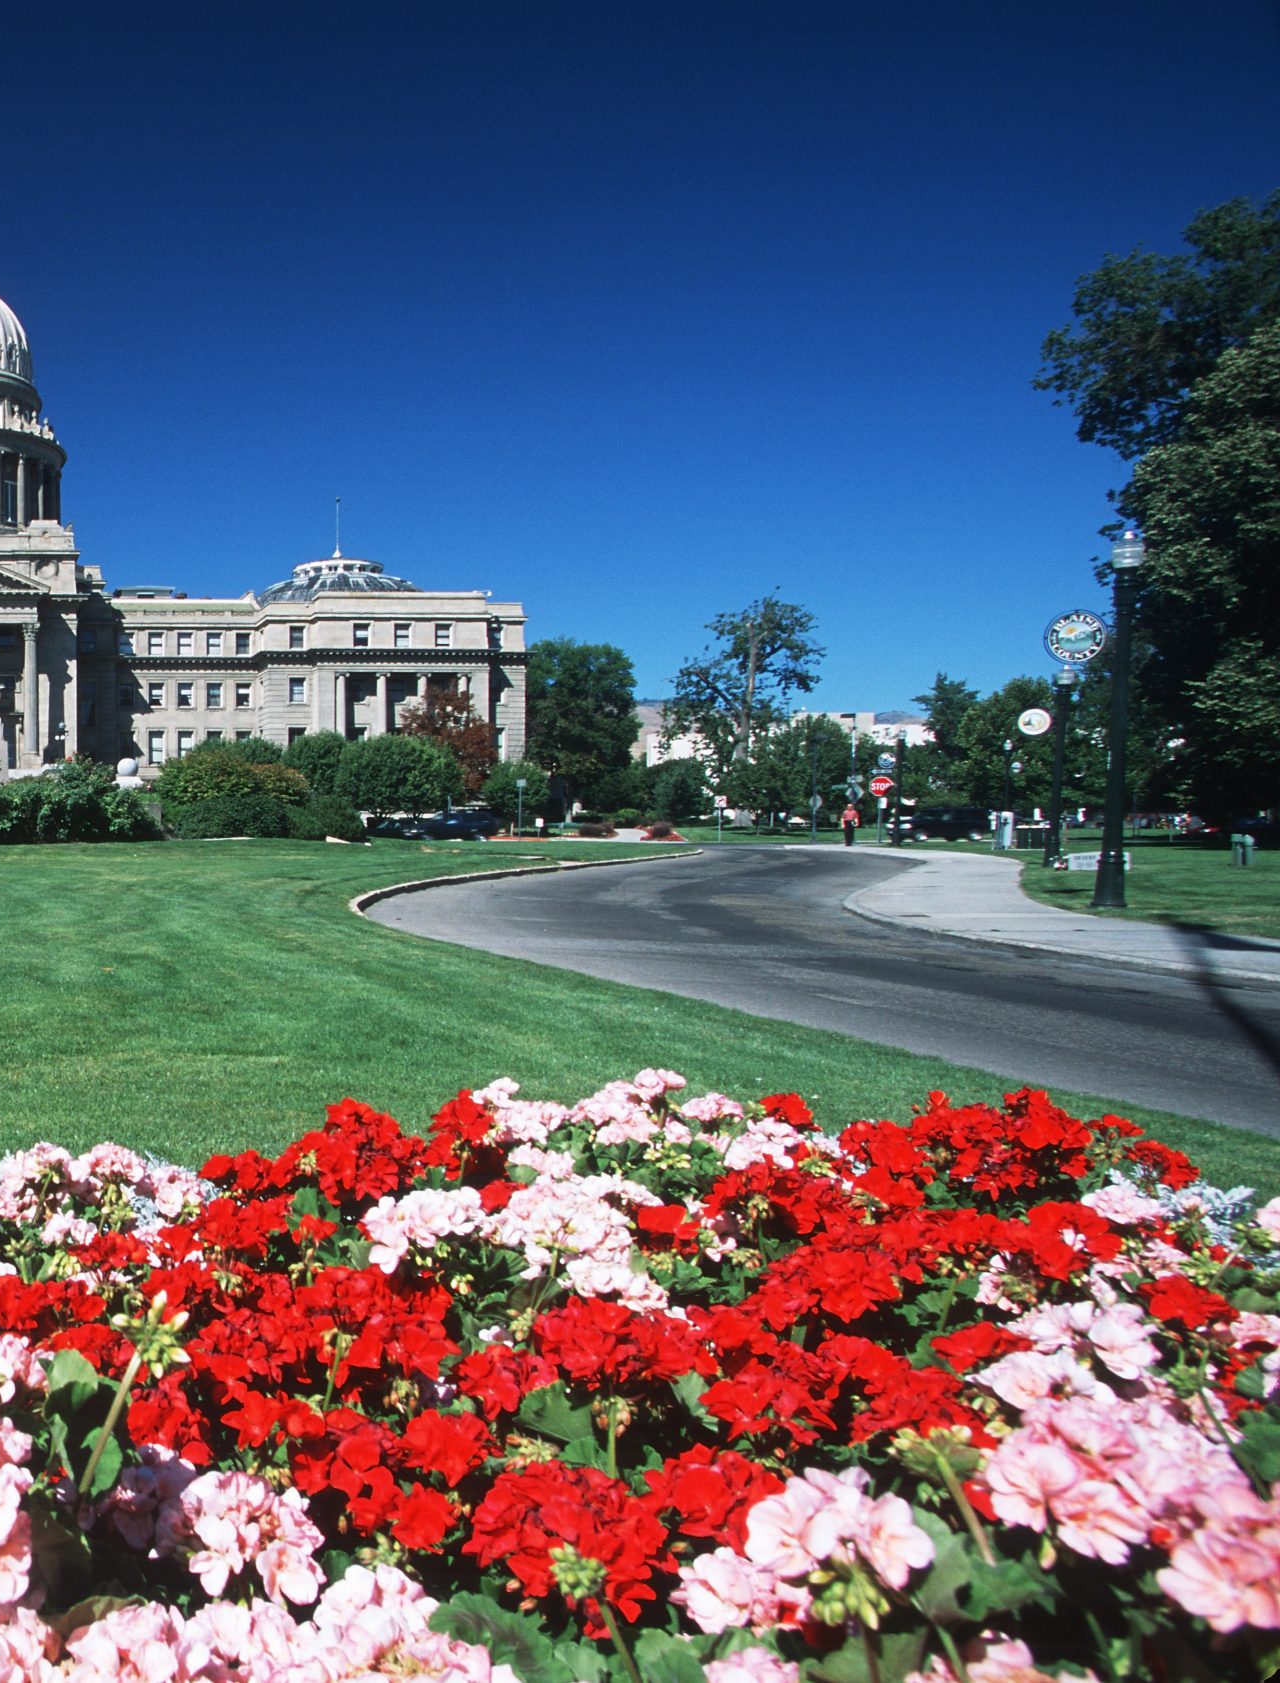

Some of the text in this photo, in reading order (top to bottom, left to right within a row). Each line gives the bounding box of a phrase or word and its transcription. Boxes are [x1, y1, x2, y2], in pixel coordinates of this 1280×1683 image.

[1053, 615, 1099, 630] BLAINE
[1052, 644, 1098, 659] COUNTY
[870, 783, 891, 791] STOP
